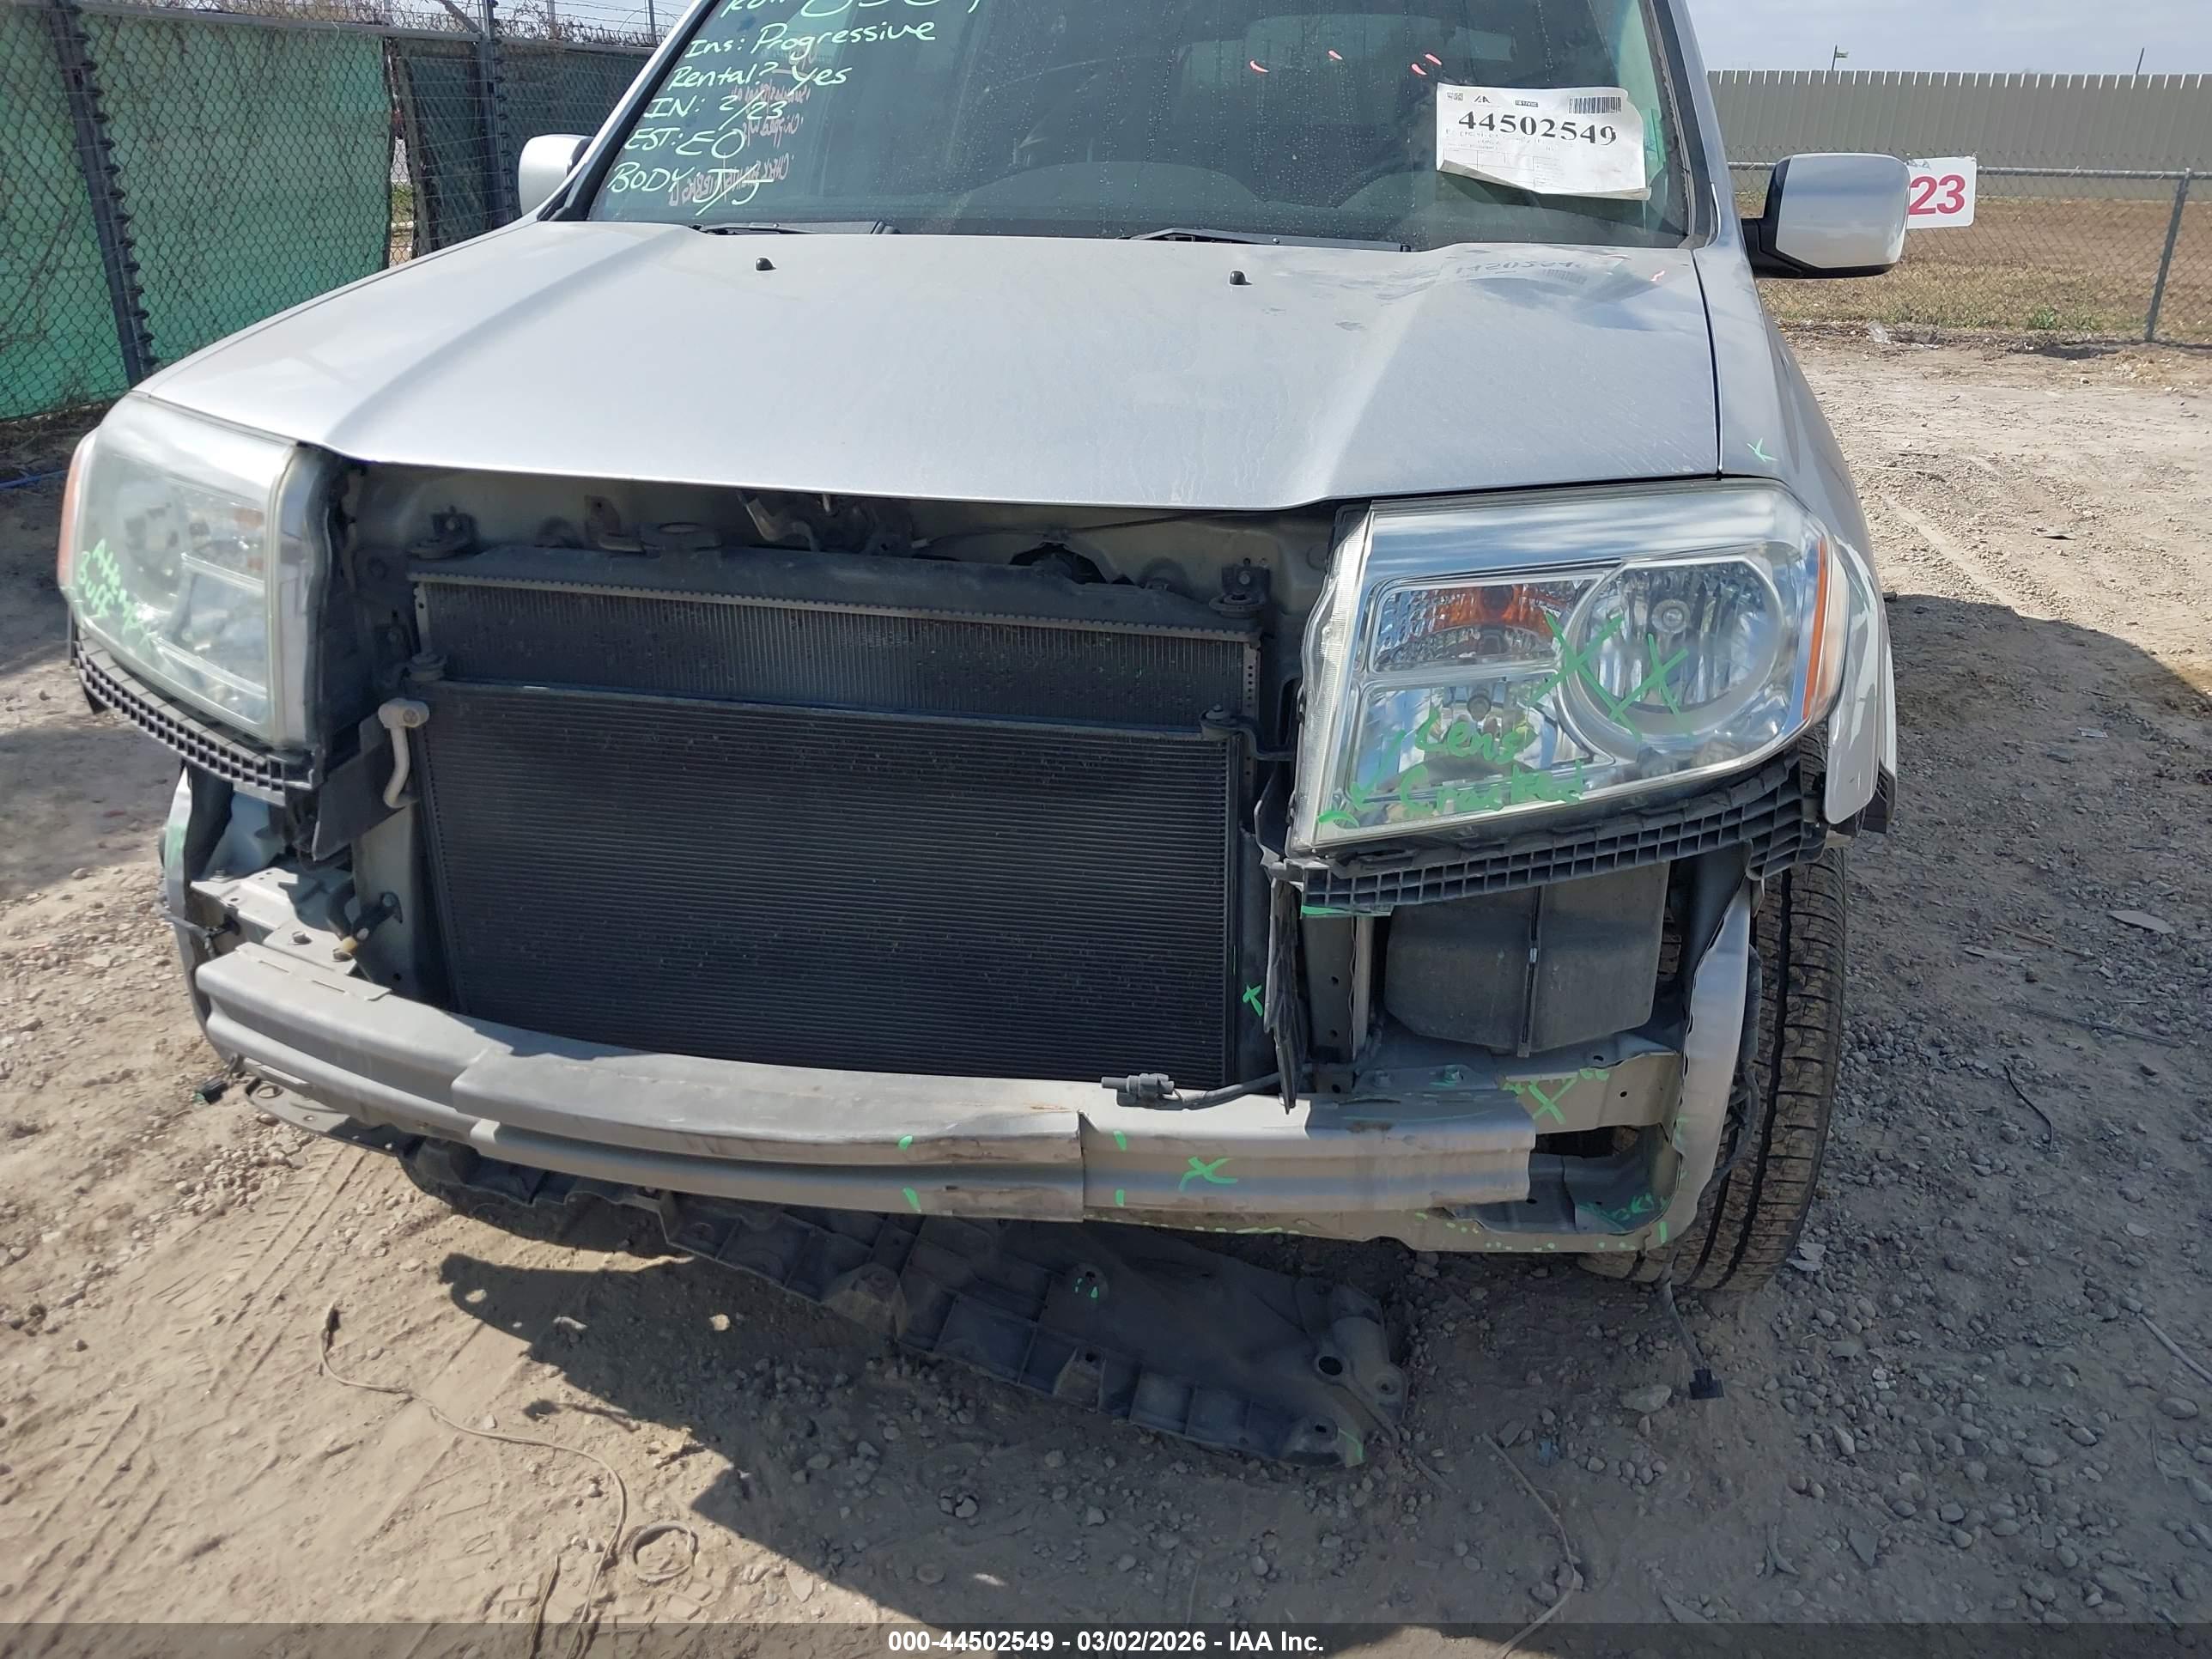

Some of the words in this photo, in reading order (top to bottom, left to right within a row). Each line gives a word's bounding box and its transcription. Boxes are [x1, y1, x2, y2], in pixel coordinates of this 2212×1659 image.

[685, 38, 746, 58] Ins:
[750, 21, 936, 61] Progressive
[667, 62, 779, 92] Rental?
[643, 95, 706, 119] IN:
[719, 89, 788, 131] 2/23
[1458, 111, 1617, 146] 44502549
[624, 128, 684, 151] EST:
[1908, 174, 1966, 215] 23
[1415, 705, 1538, 765] Lens
